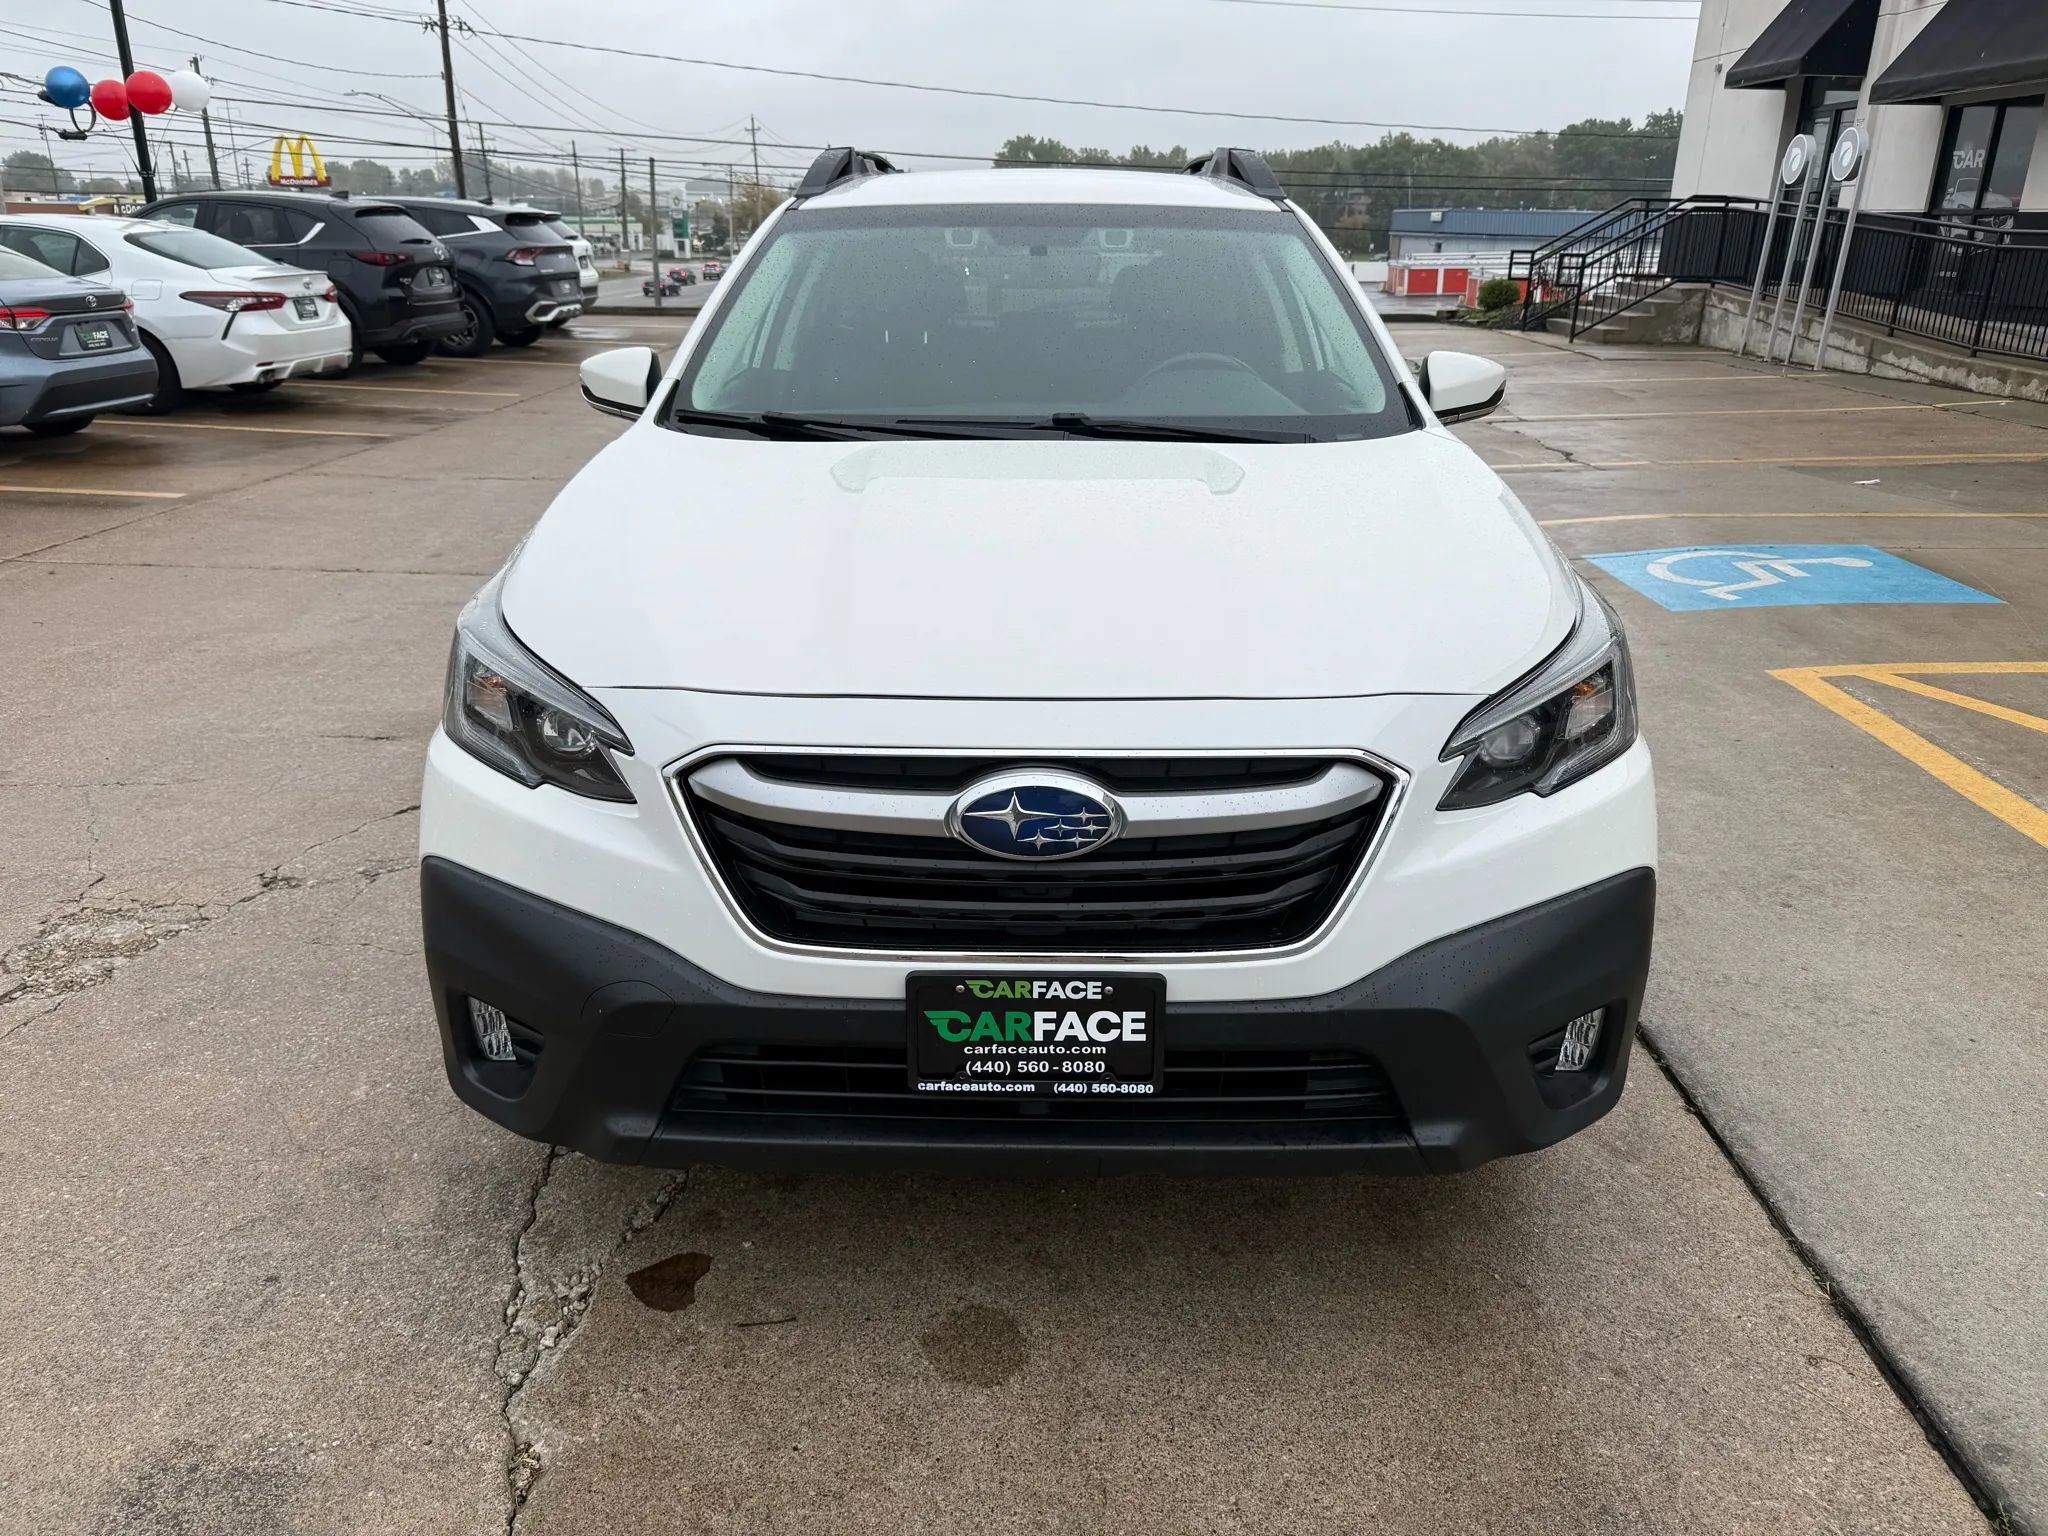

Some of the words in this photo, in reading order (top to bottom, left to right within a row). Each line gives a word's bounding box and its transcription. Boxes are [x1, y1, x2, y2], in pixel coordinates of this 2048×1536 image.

[965, 980, 1102, 999] CARFACE
[924, 1011, 1146, 1042] CARFACE
[964, 1044, 1106, 1054] carfaceauto.com
[966, 1061, 1011, 1075] (440)
[918, 1082, 1035, 1092] carfaceauto.com
[1054, 1083, 1087, 1094] (440)
[1091, 1084, 1154, 1094] 560-8080
